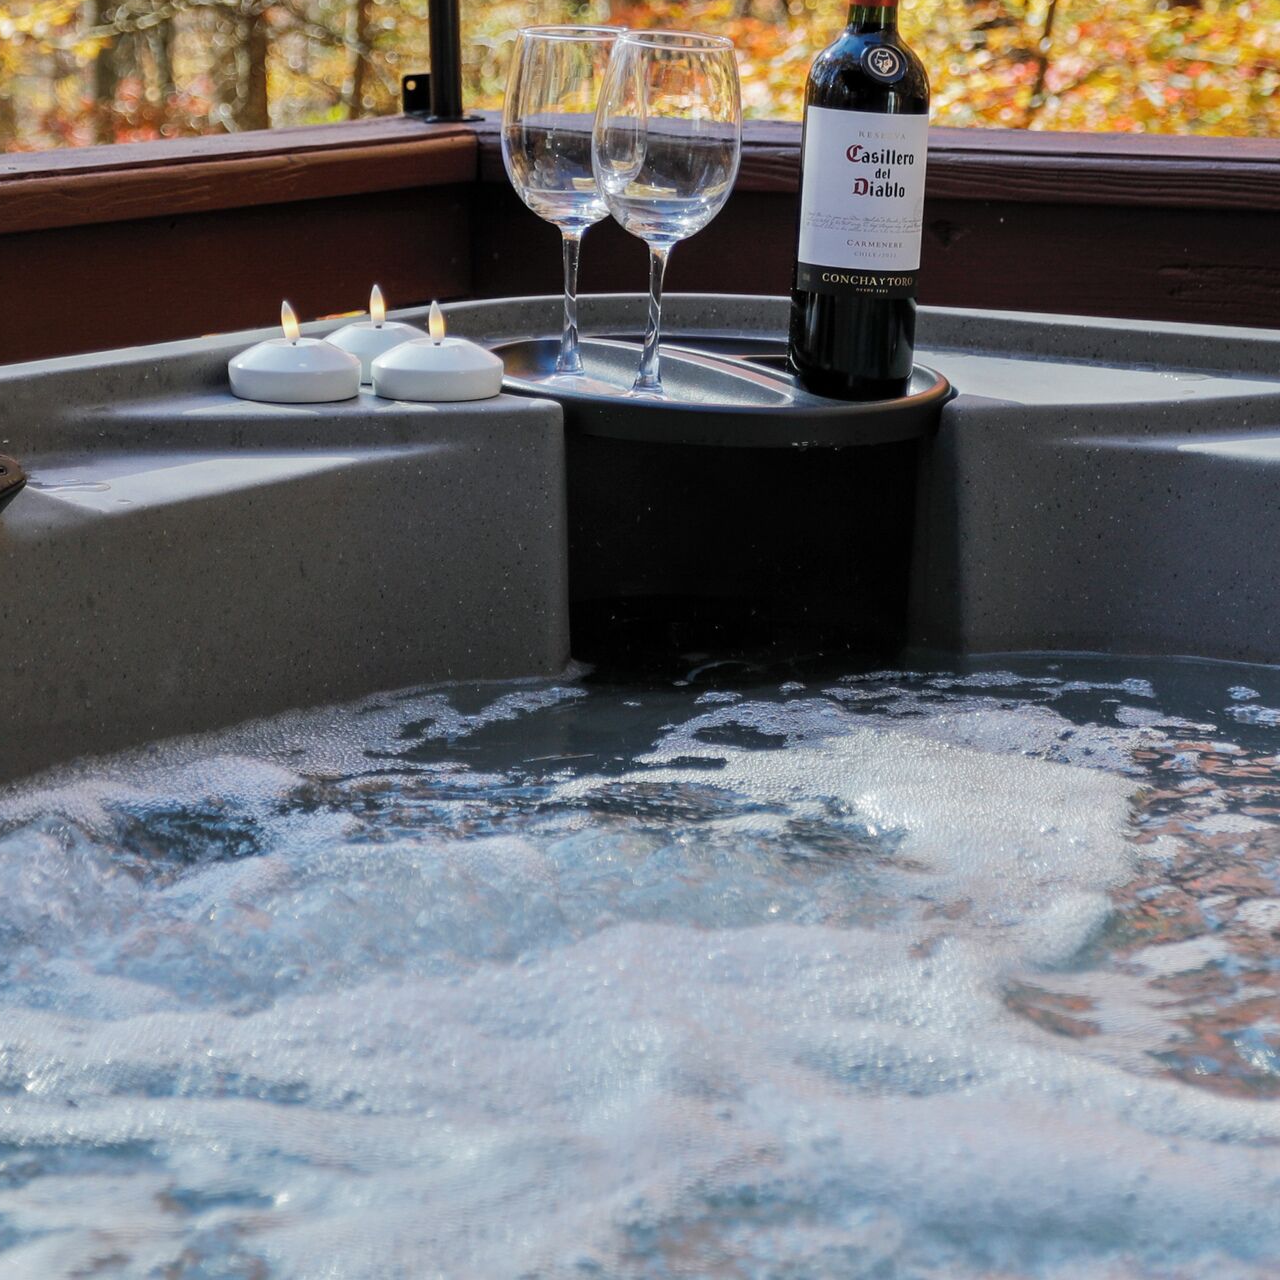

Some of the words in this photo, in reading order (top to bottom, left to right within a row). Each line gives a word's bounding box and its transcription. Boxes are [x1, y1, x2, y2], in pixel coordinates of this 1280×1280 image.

[846, 144, 915, 165] Casillero
[875, 168, 891, 179] del
[852, 178, 905, 198] Diablo
[822, 272, 877, 286] CONCHA
[879, 278, 886, 286] Y
[887, 277, 913, 287] TORO
